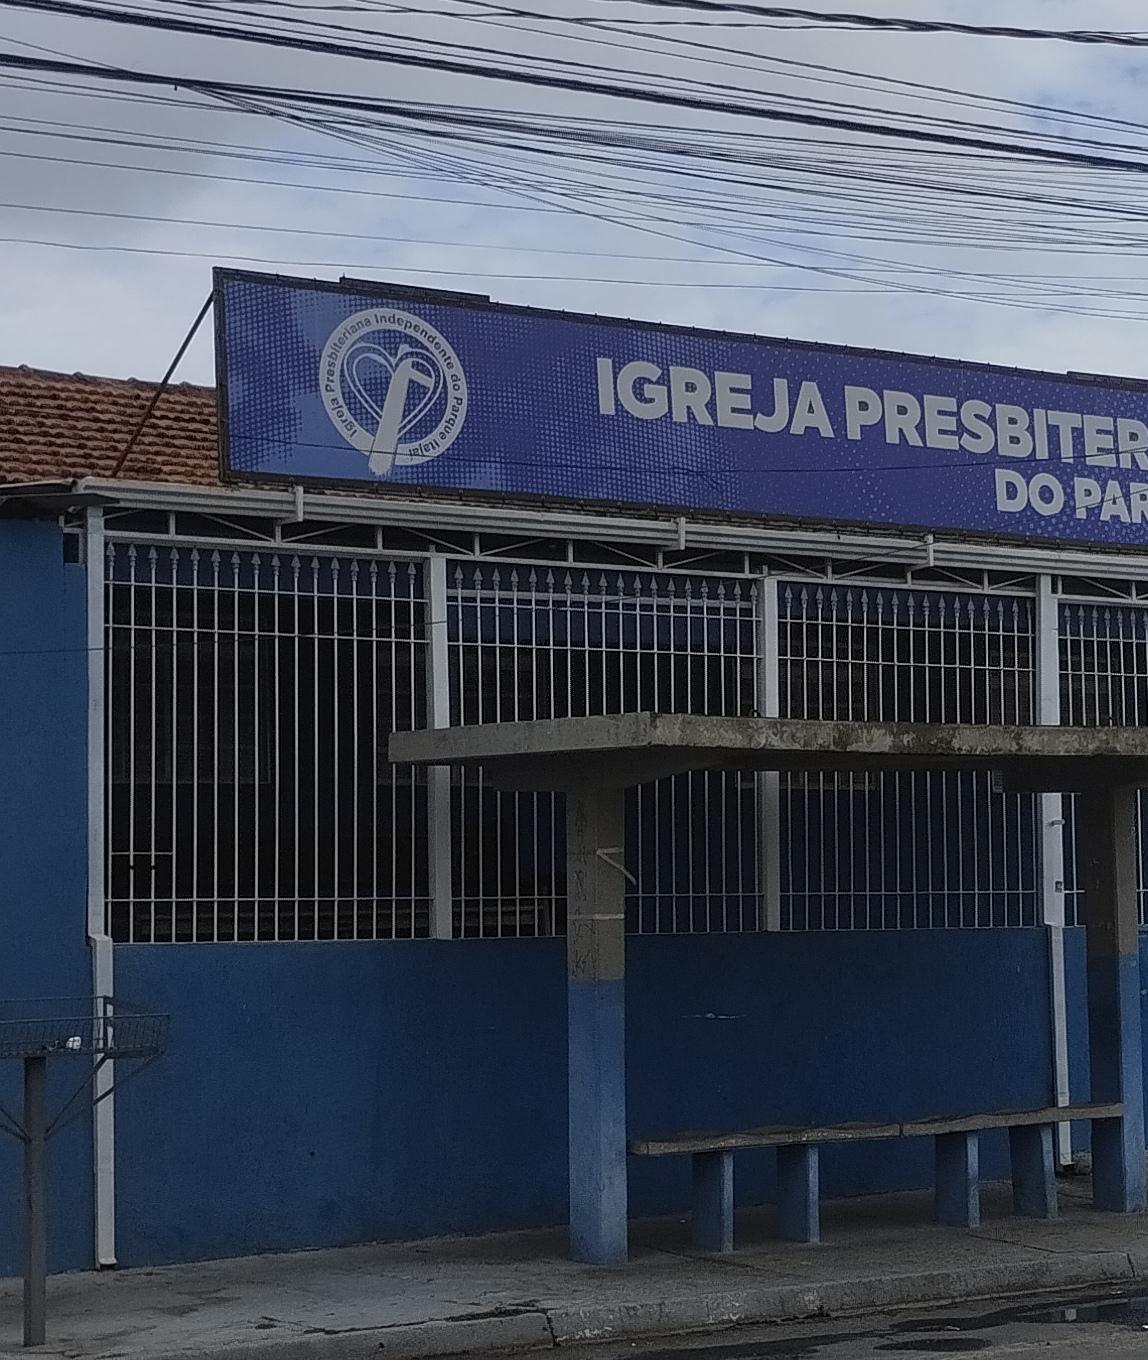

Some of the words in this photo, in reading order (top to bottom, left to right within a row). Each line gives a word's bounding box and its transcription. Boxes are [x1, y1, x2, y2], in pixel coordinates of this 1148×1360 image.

[325, 316, 373, 394] Presbiteriana
[374, 312, 455, 371] Independente
[450, 372, 462, 391] do
[596, 357, 835, 439] IGREJA
[330, 396, 358, 439] Igreja
[438, 396, 464, 441] Parque
[994, 468, 1065, 516] DO
